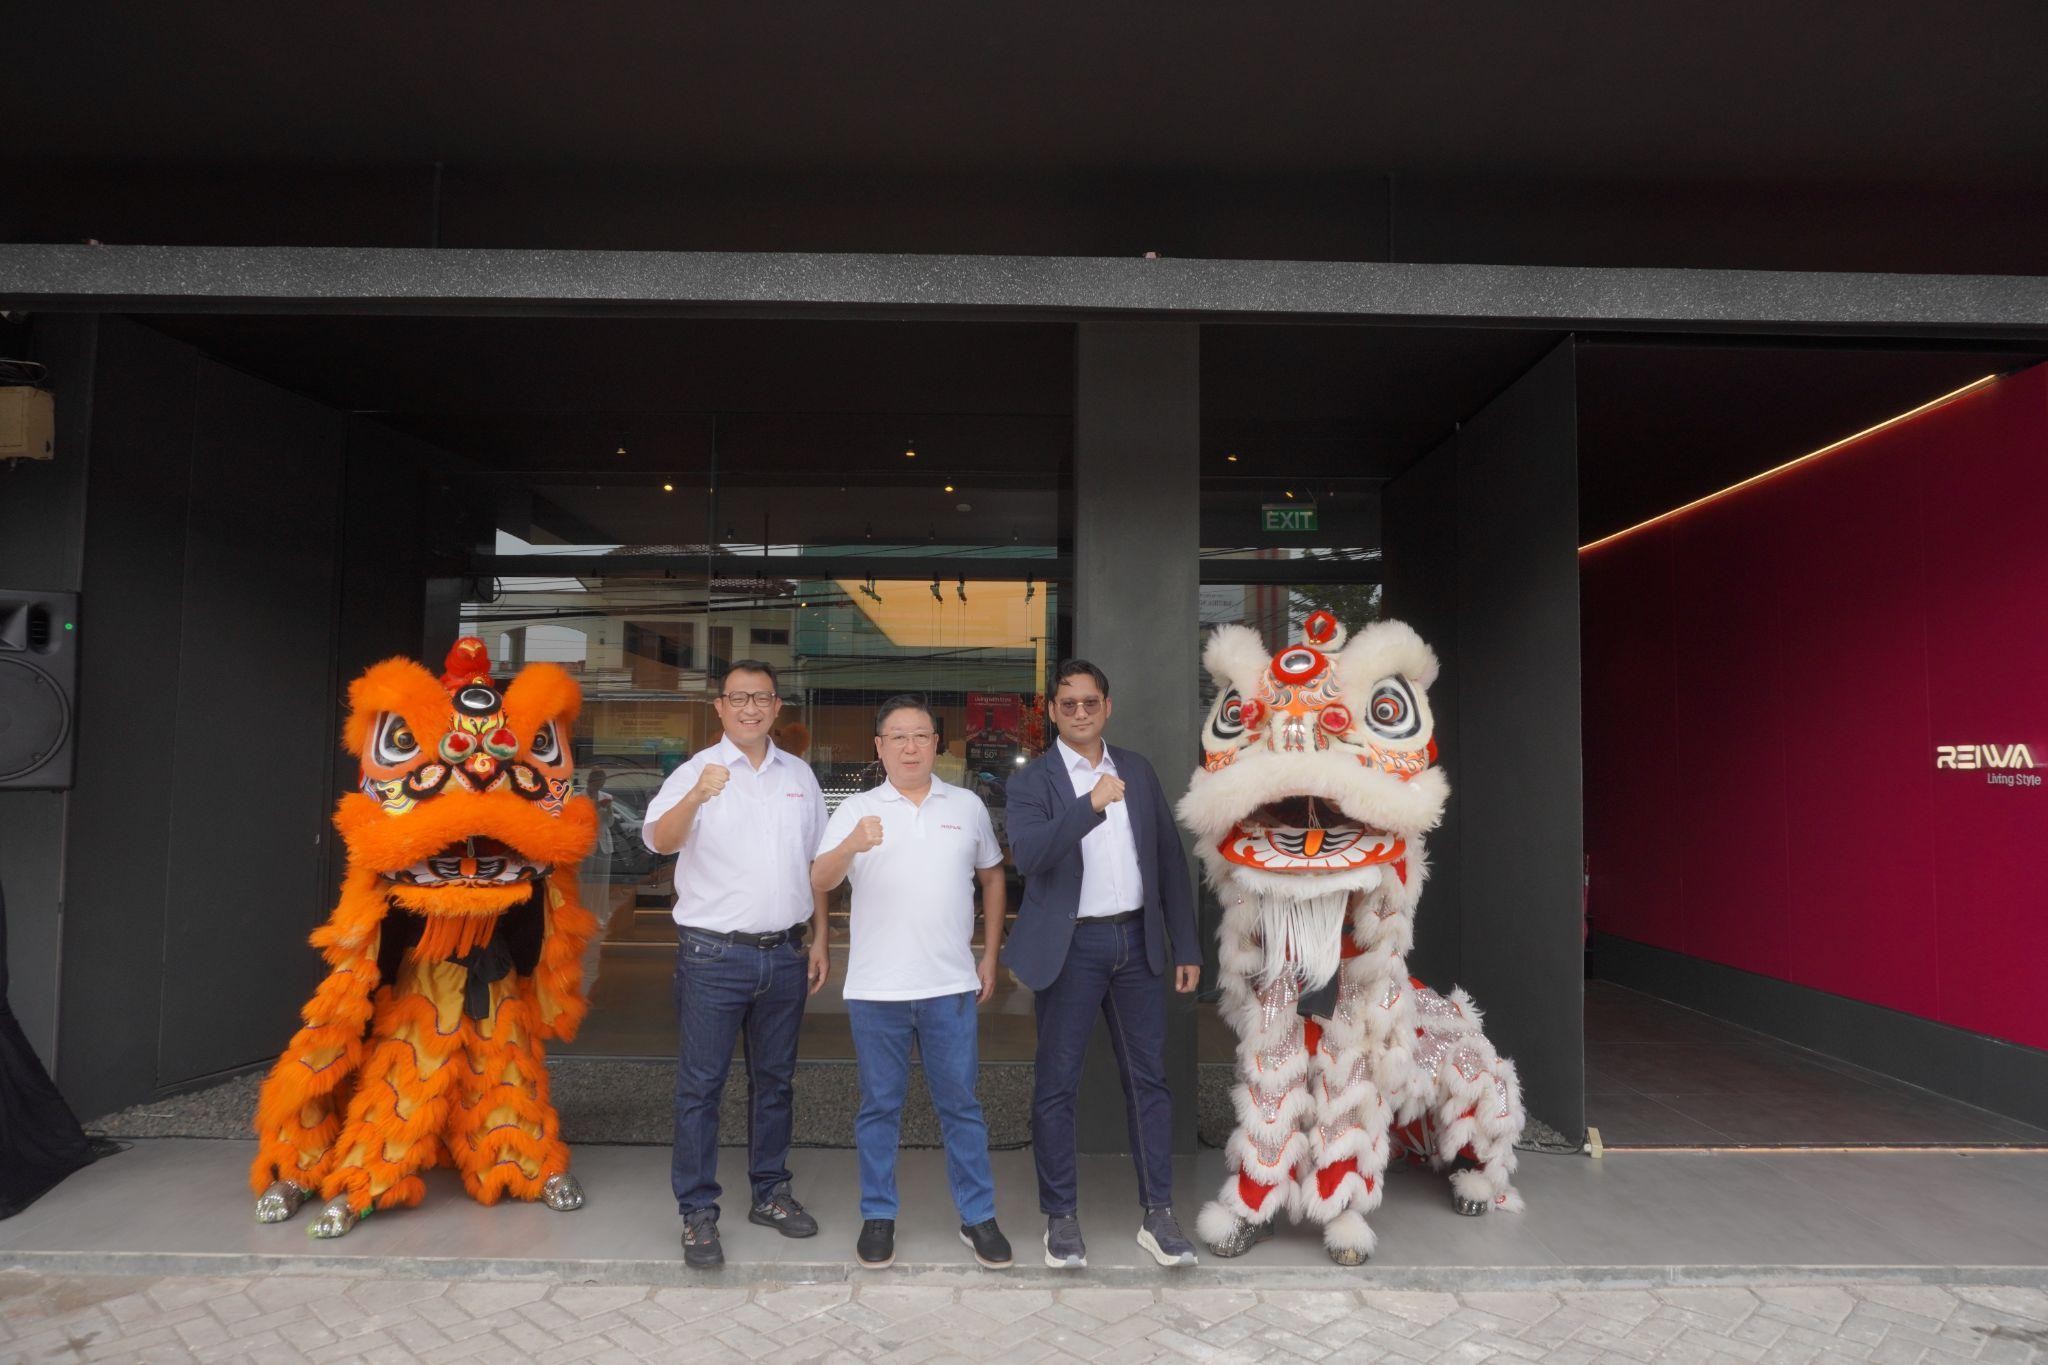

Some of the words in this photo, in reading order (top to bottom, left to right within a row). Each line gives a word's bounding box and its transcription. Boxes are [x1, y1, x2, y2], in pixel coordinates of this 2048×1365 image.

[1266, 511, 1312, 528] EXIT
[1937, 744, 2034, 769] REIWA
[1987, 773, 2014, 786] Living
[2016, 774, 2041, 786] Style
